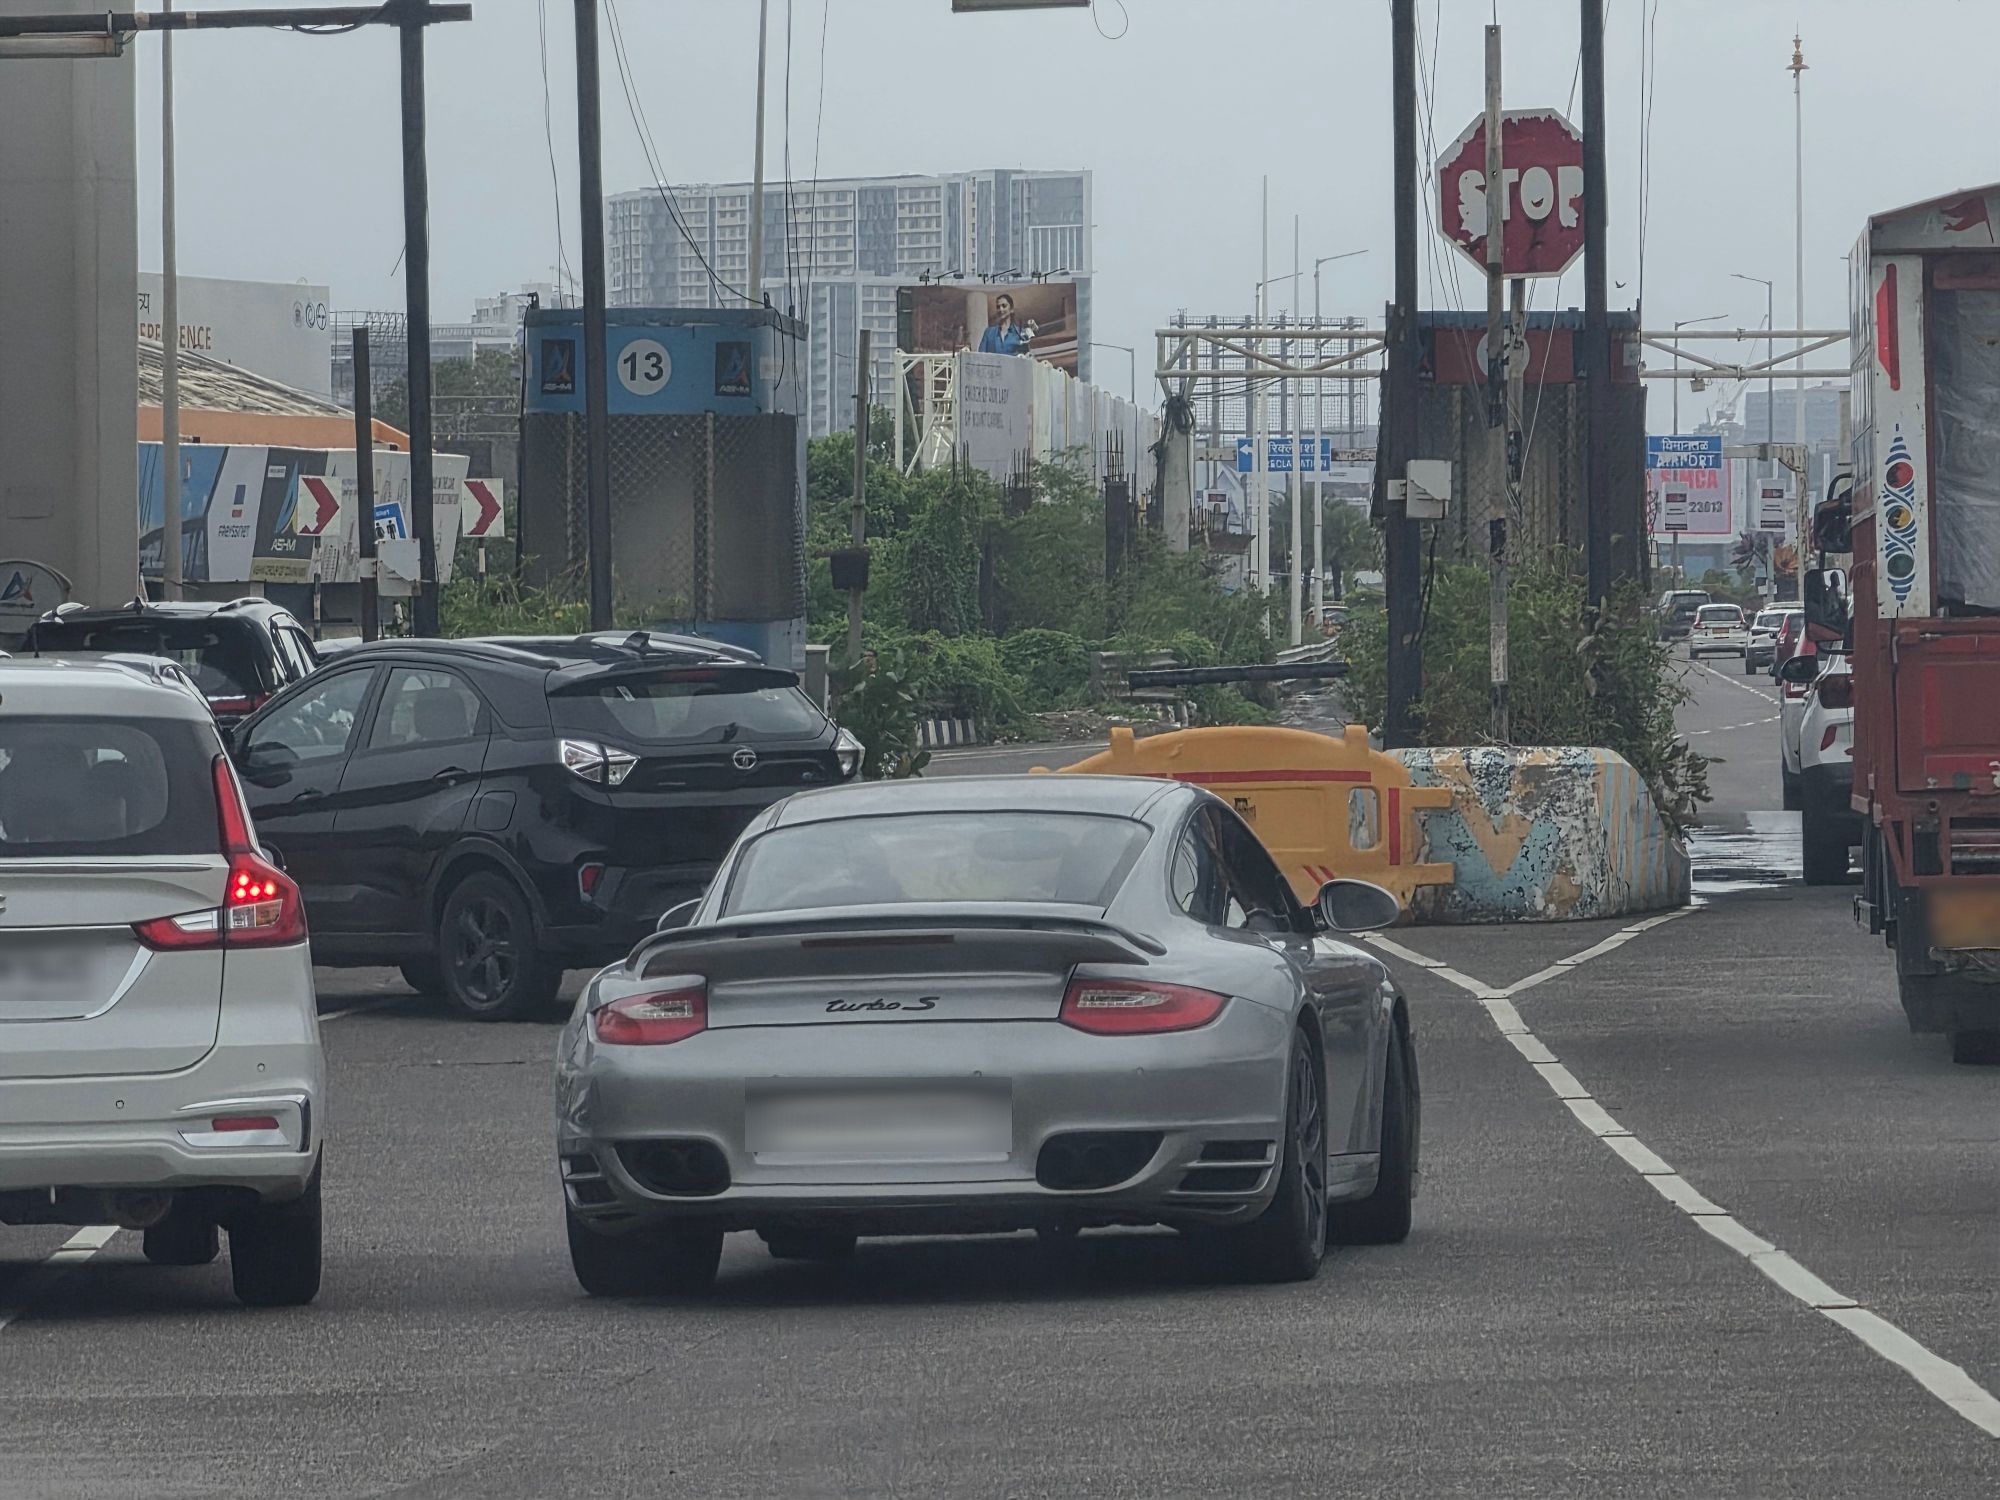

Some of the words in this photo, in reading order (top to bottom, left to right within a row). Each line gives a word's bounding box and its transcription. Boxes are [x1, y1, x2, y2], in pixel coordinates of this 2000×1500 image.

[1458, 166, 1584, 234] STOP
[623, 351, 664, 382] 13
[1656, 454, 1716, 468] AIRPORT
[825, 998, 901, 1013] turbo
[901, 996, 940, 1011] S
